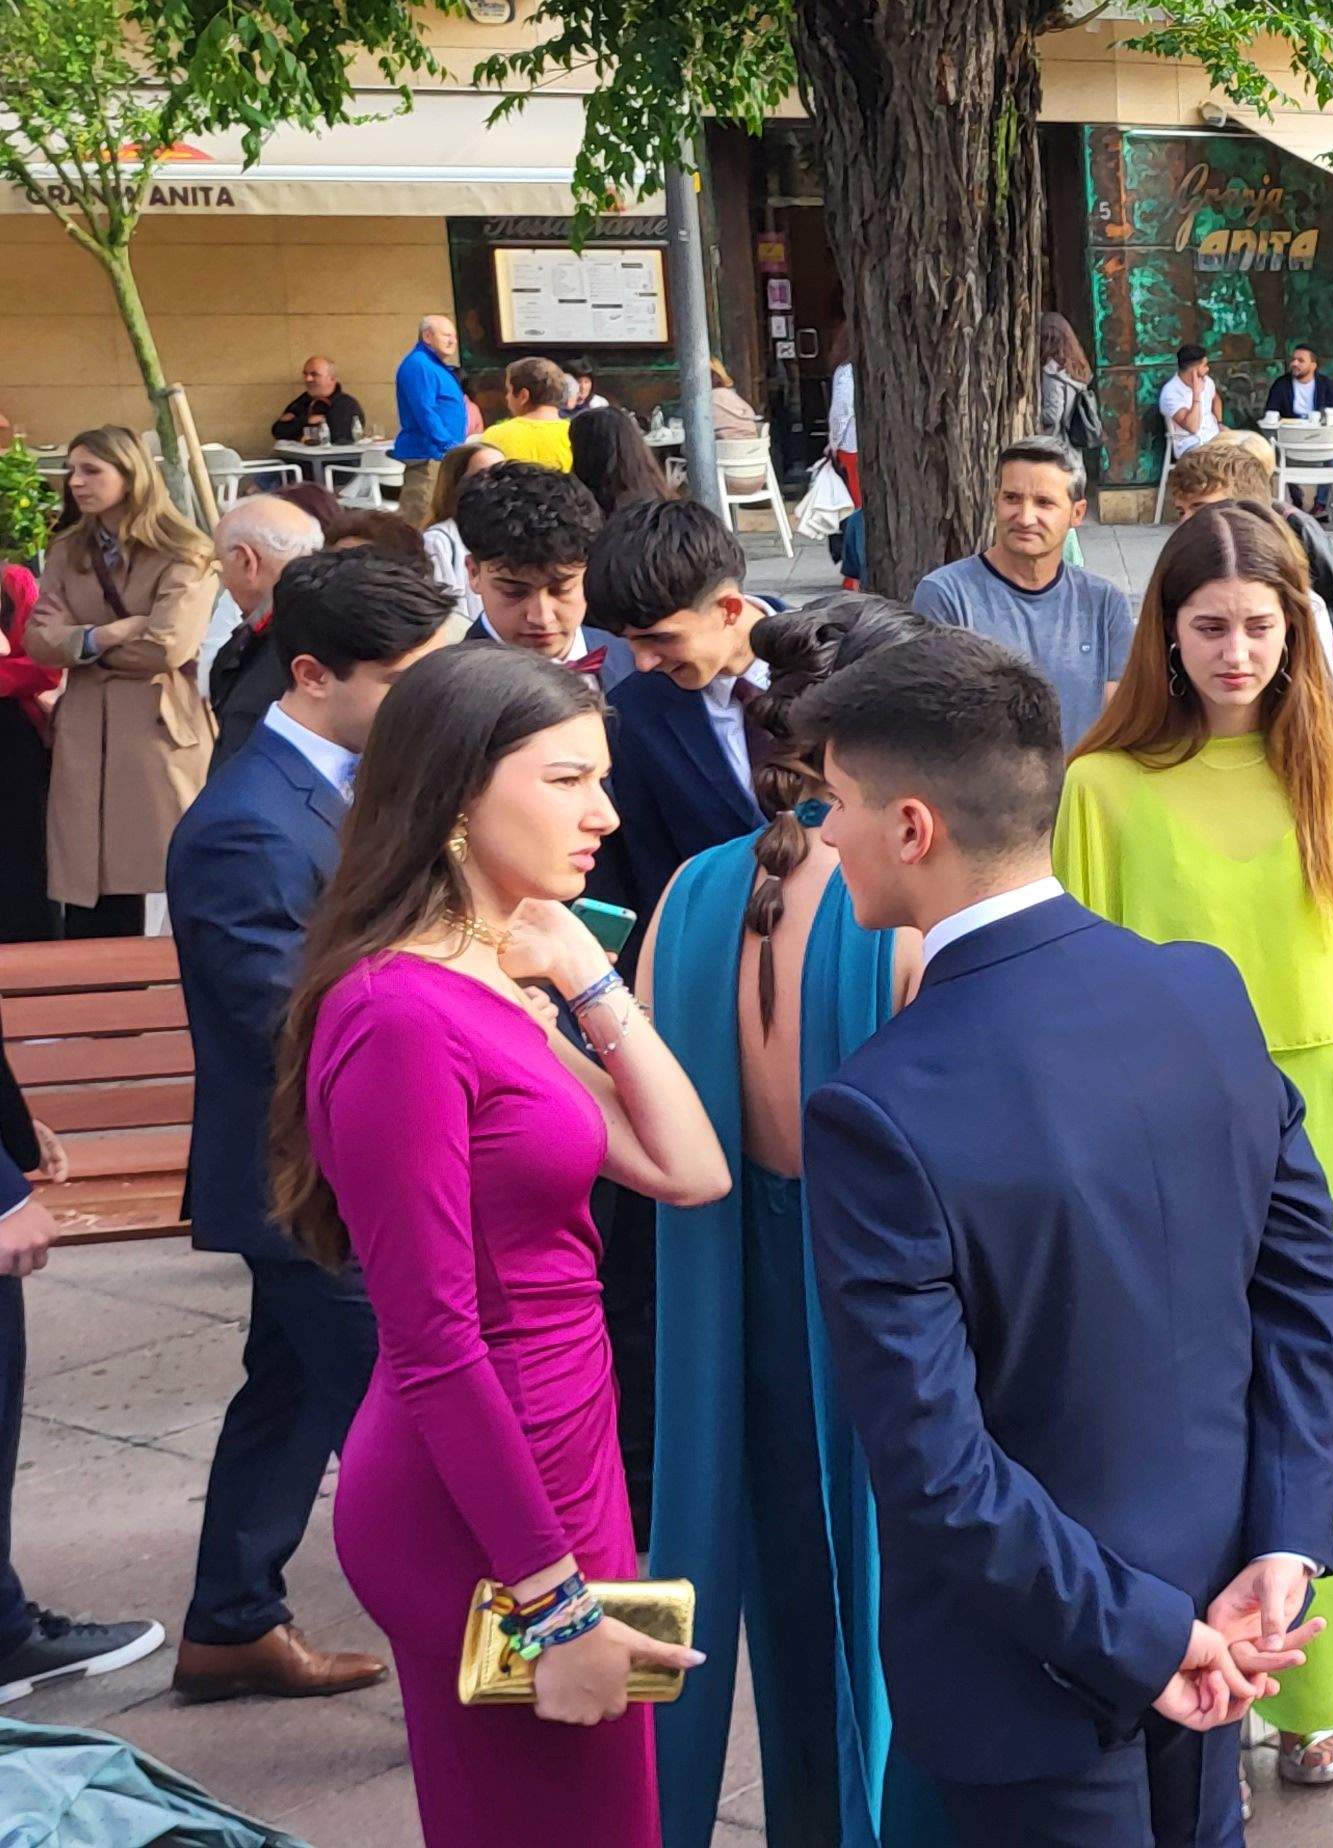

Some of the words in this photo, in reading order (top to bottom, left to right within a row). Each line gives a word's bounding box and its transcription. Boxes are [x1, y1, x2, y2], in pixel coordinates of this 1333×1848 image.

[149, 185, 236, 207] ANITA
[1099, 201, 1112, 221] 5
[1175, 163, 1285, 252] Granja
